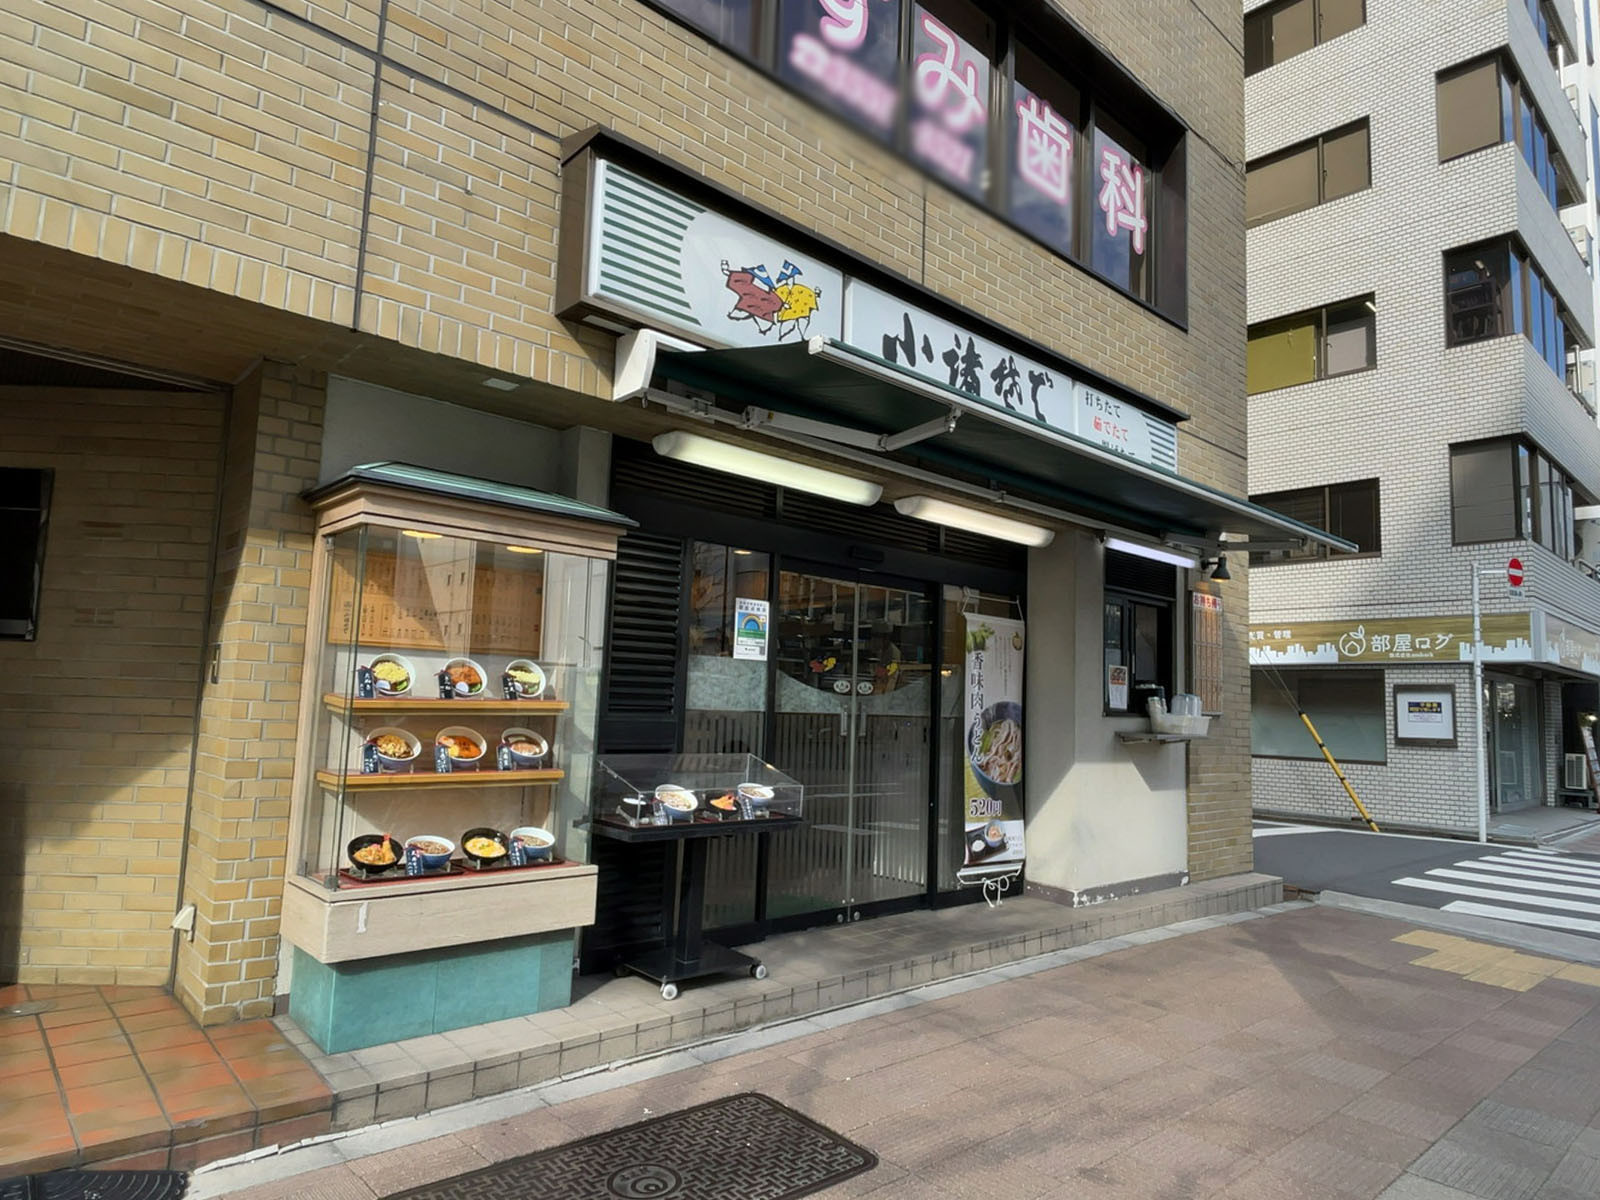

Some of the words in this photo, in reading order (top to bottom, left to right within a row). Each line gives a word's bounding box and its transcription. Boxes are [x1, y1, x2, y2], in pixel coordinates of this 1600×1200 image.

[1085, 391, 1121, 419] 打ちたて
[1371, 633, 1455, 652] 部屋ログ
[969, 651, 985, 763] 香味肉うどん
[971, 798, 1001, 817] 520円
